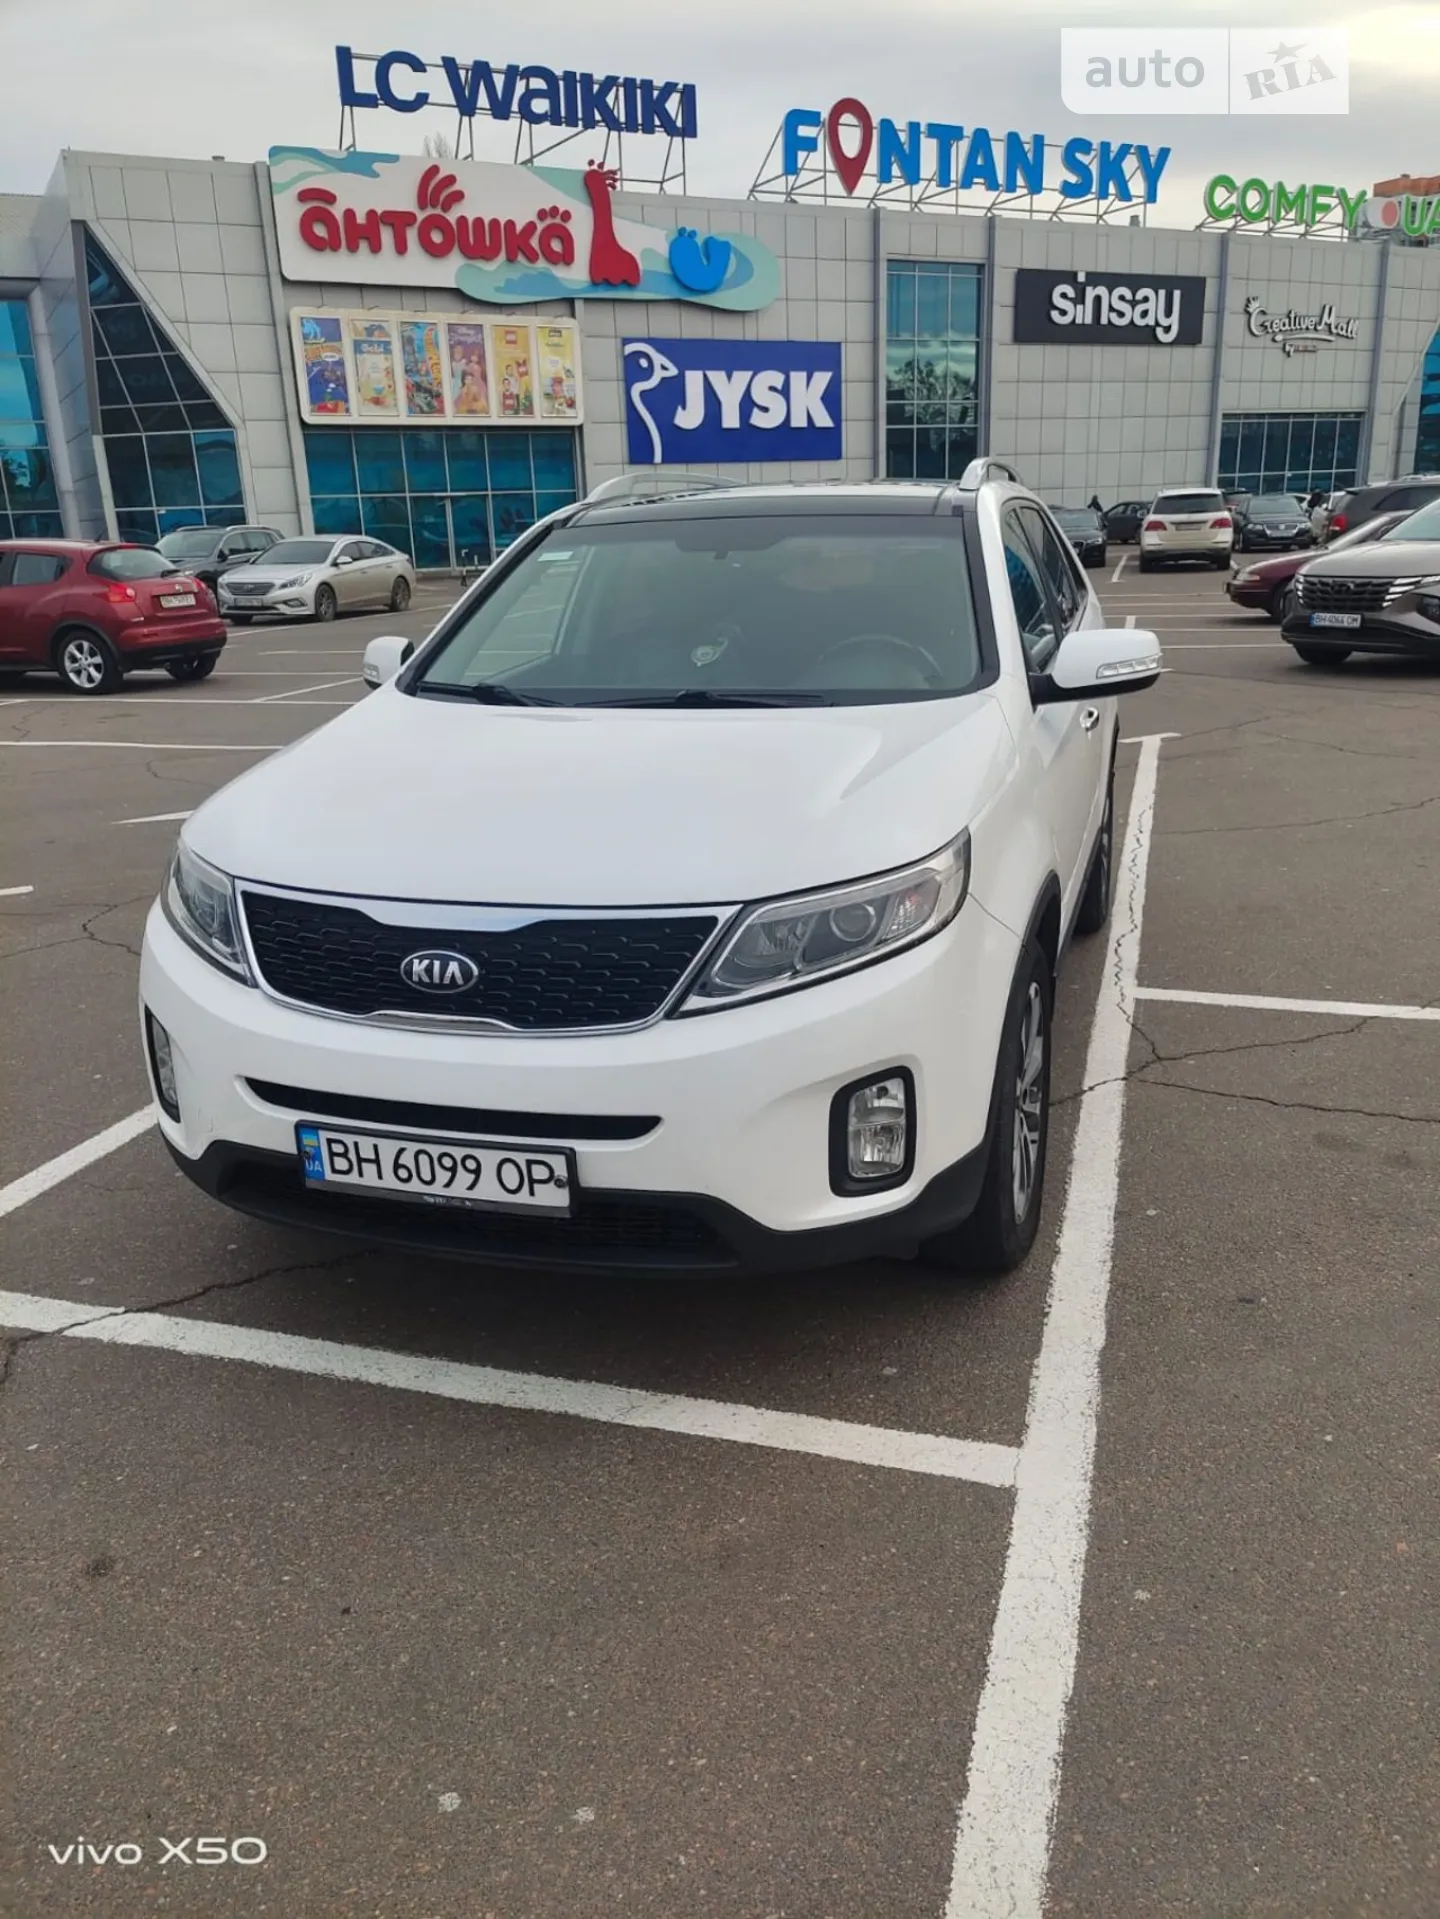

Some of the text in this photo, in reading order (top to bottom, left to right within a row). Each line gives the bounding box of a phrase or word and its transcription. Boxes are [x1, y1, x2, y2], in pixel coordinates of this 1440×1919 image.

[335, 45, 430, 113] LC
[1060, 137, 1171, 204] SKY
[1203, 173, 1367, 231] COMFY
[1050, 271, 1181, 344] sinsay
[1248, 303, 1360, 338] Creative Mall
[673, 369, 835, 430] JYSK
[411, 958, 463, 985] KIA
[305, 1159, 323, 1172] UA
[392, 1147, 482, 1191] 6099
